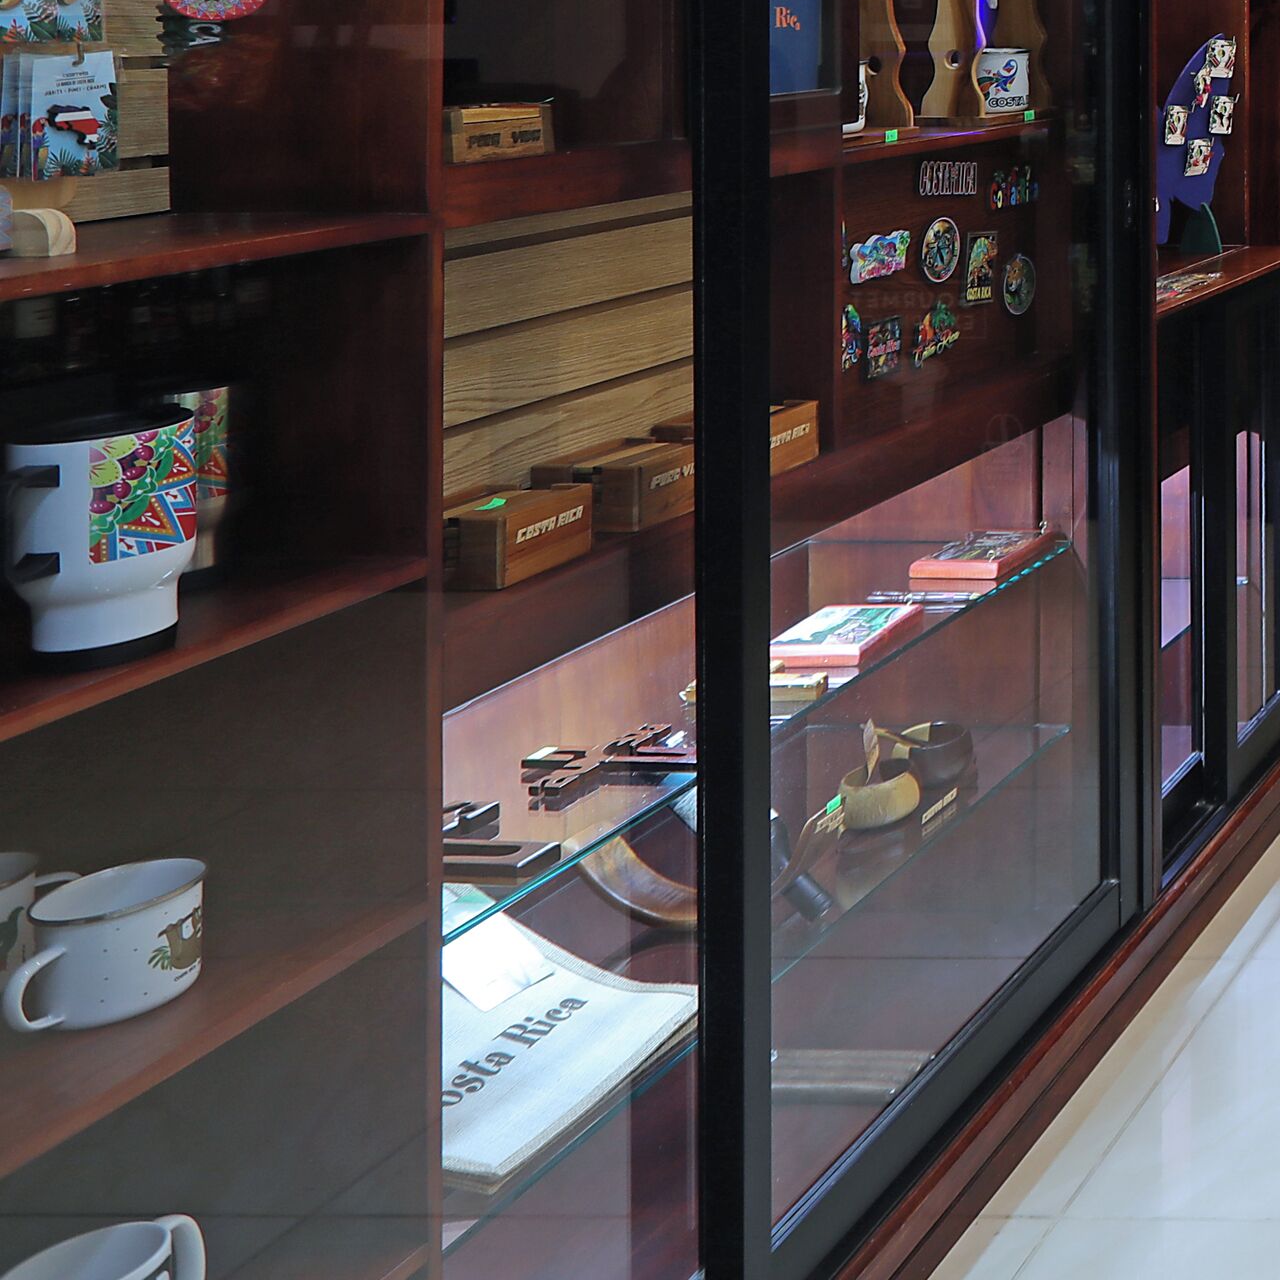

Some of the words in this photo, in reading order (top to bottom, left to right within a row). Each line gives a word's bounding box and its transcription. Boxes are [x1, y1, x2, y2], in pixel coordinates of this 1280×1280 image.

[775, 6, 801, 31] Rica
[988, 95, 1026, 108] COSTA
[919, 161, 952, 196] COSTA
[966, 287, 982, 301] COSTA
[981, 286, 992, 300] RICA
[515, 516, 556, 544] COSTA
[556, 505, 584, 529] RICA
[492, 998, 589, 1050] Rica
